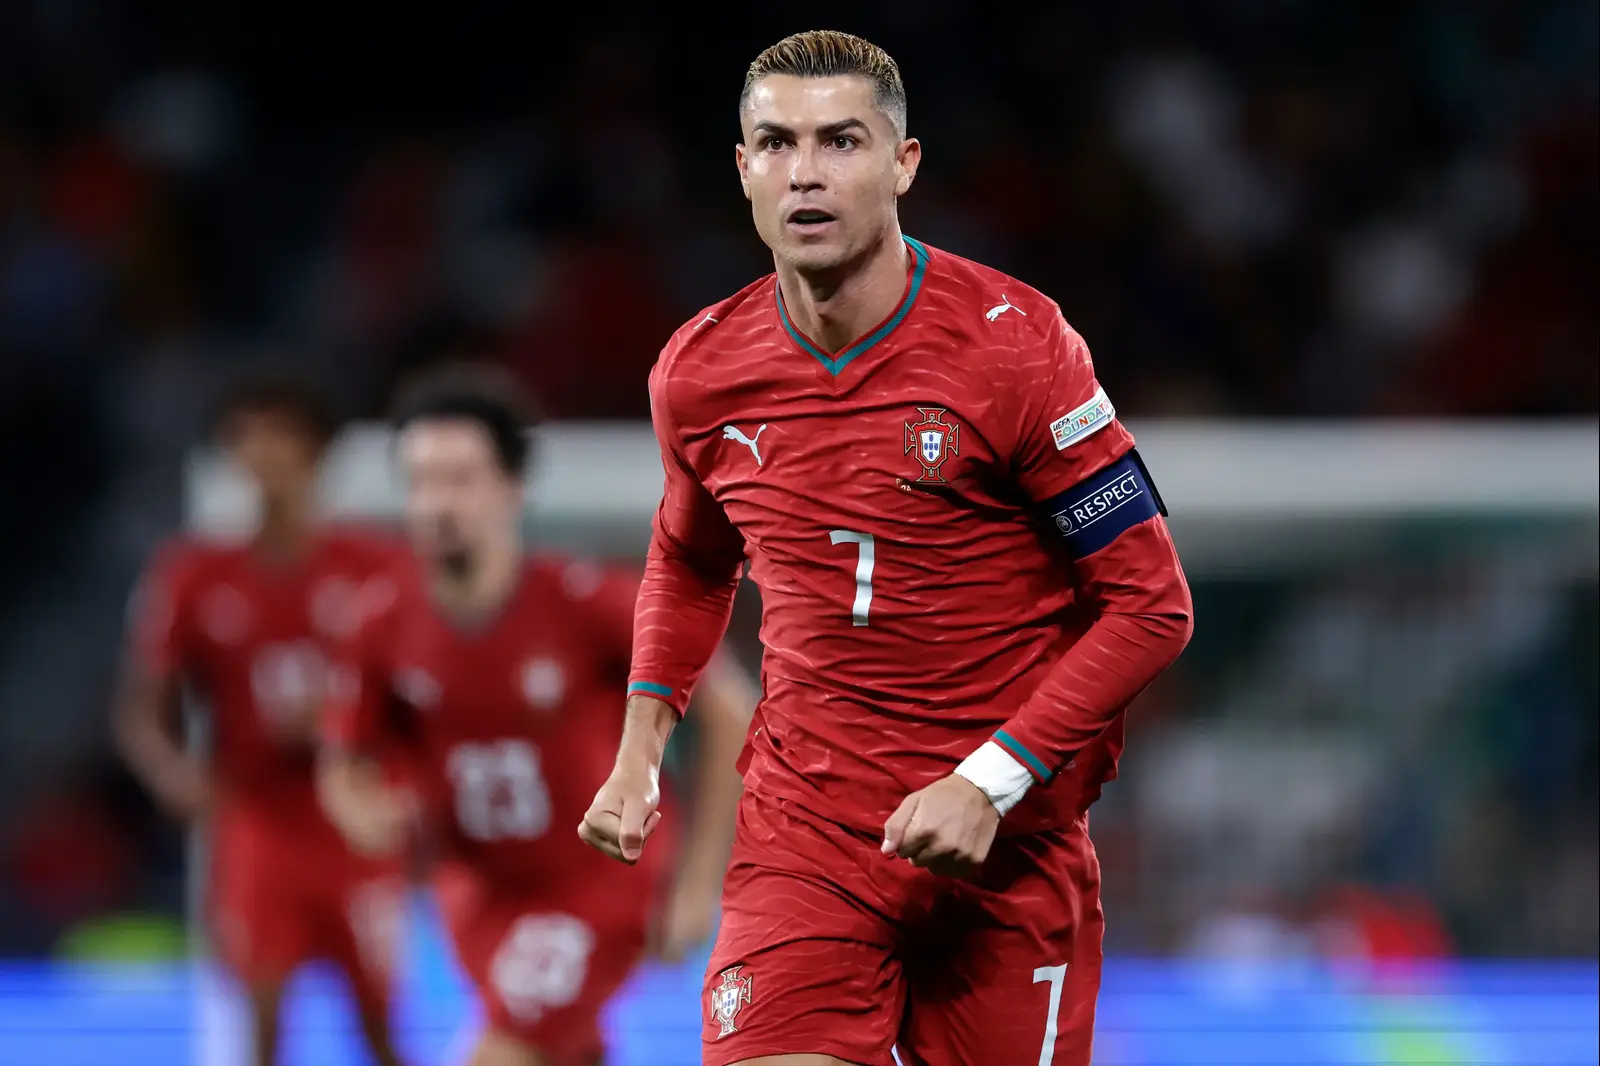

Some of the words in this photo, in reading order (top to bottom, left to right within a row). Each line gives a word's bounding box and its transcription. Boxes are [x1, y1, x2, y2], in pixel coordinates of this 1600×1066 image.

[1053, 418, 1071, 431] UEFA
[1073, 475, 1138, 524] RESPECT
[828, 529, 876, 627] 7
[1032, 962, 1069, 1066] 7
